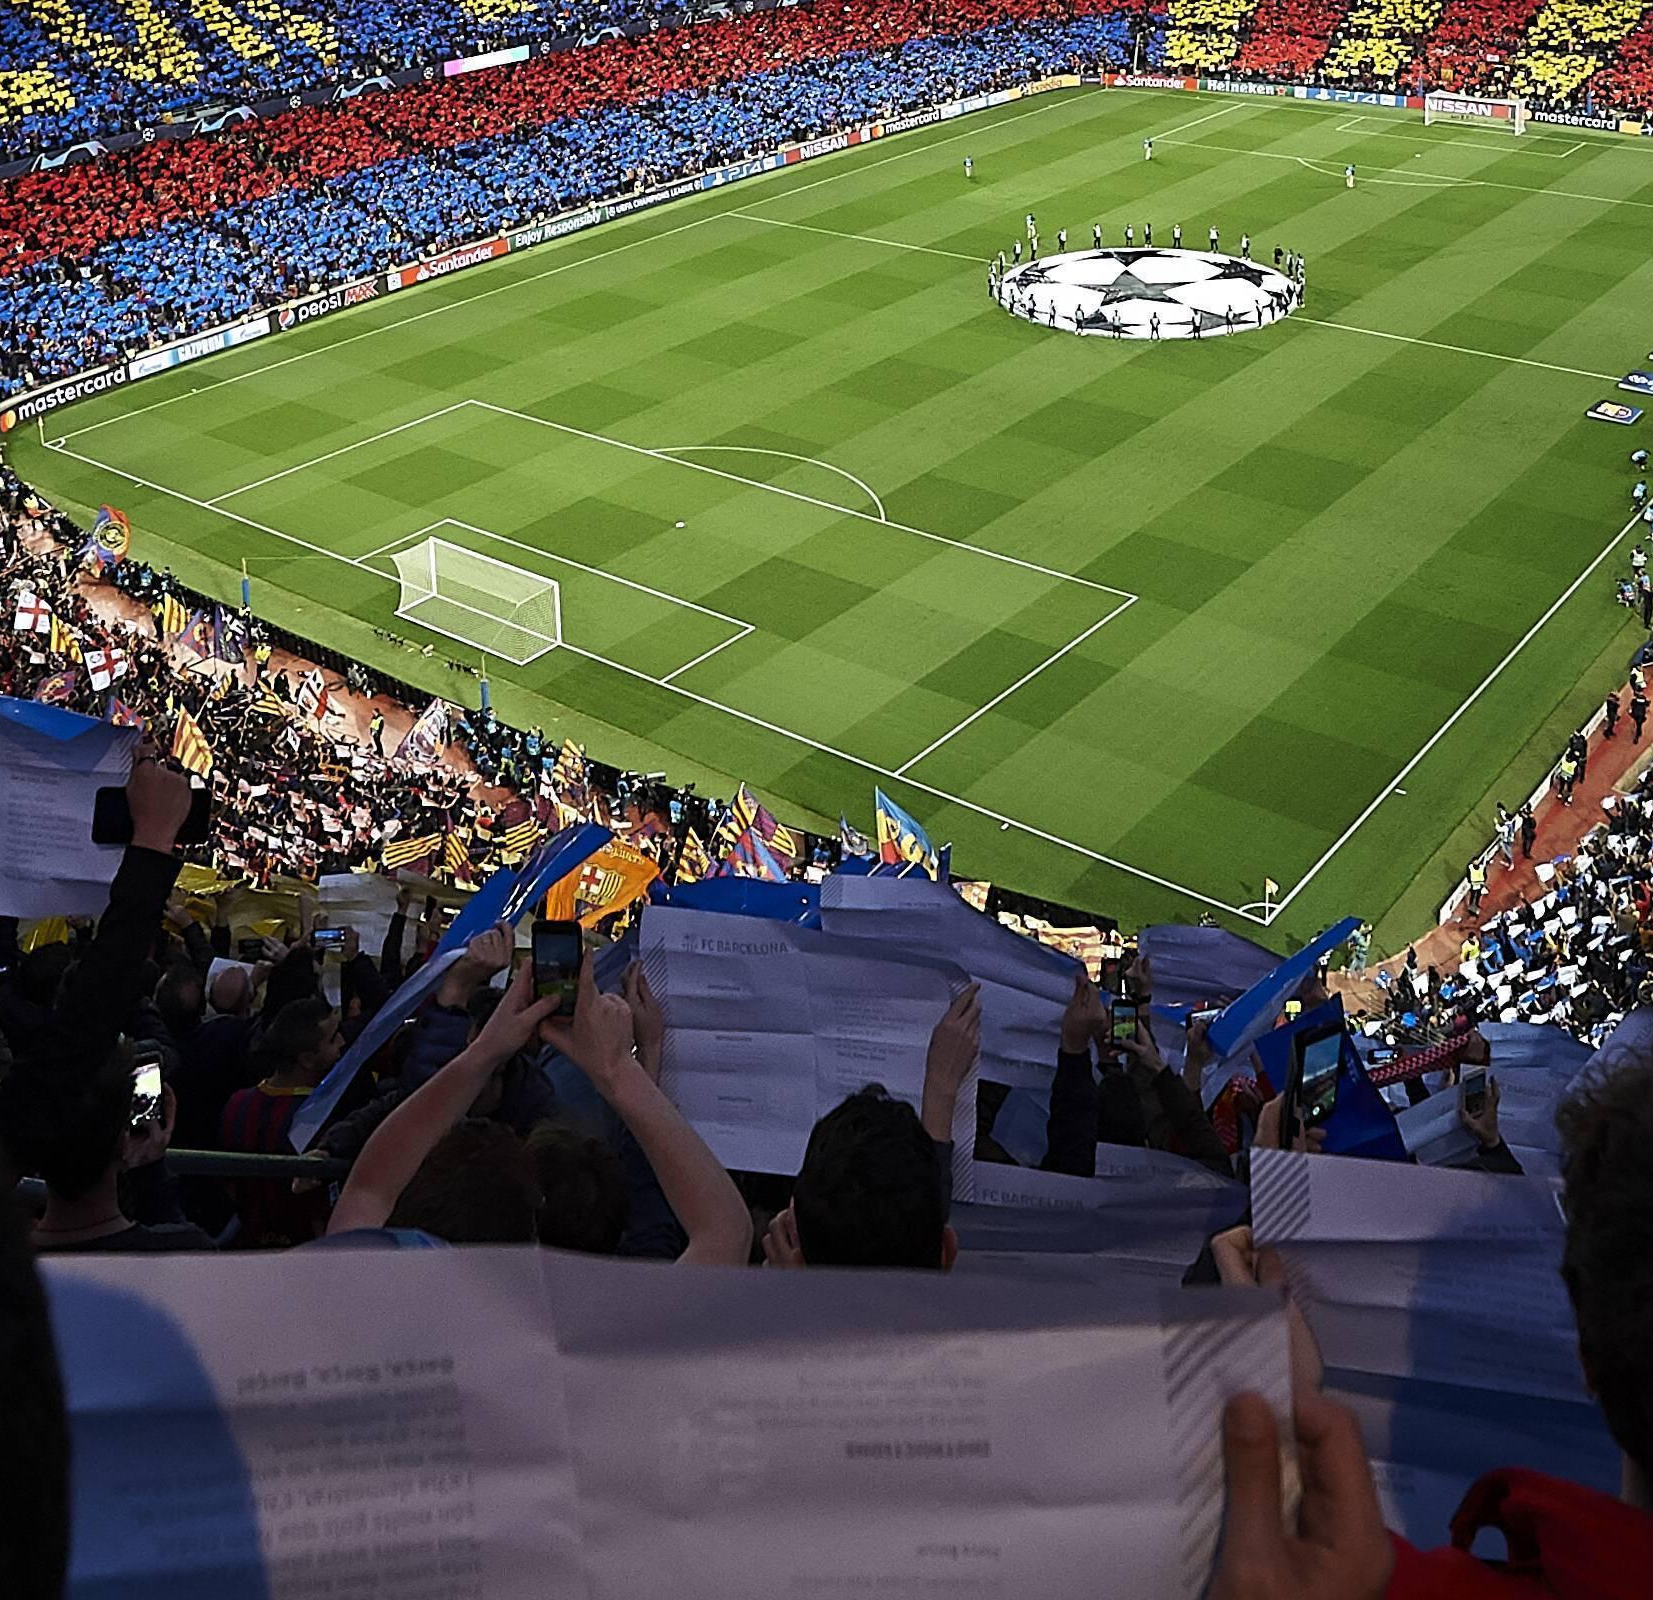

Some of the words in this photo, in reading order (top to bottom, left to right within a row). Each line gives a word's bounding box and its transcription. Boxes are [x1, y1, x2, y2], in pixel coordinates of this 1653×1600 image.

[1126, 75, 1185, 90] Santander
[1206, 79, 1275, 96] Heineken
[1335, 89, 1378, 105] PS4
[1428, 98, 1493, 117] NISSAN
[885, 109, 939, 134] mastercard
[1534, 110, 1617, 130] mastercard
[800, 134, 849, 161] NISSAN
[670, 182, 694, 198] LEAGUE
[514, 227, 543, 249] Enjoy
[543, 208, 602, 240] Responsibly
[428, 244, 494, 277] Santander
[298, 293, 343, 324] pepsi
[18, 365, 127, 421] mastercard
[700, 938, 715, 952] FC
[717, 939, 789, 956] BARCELONA
[981, 1189, 1000, 1204] FC
[1001, 1192, 1084, 1212] BARCELONA
